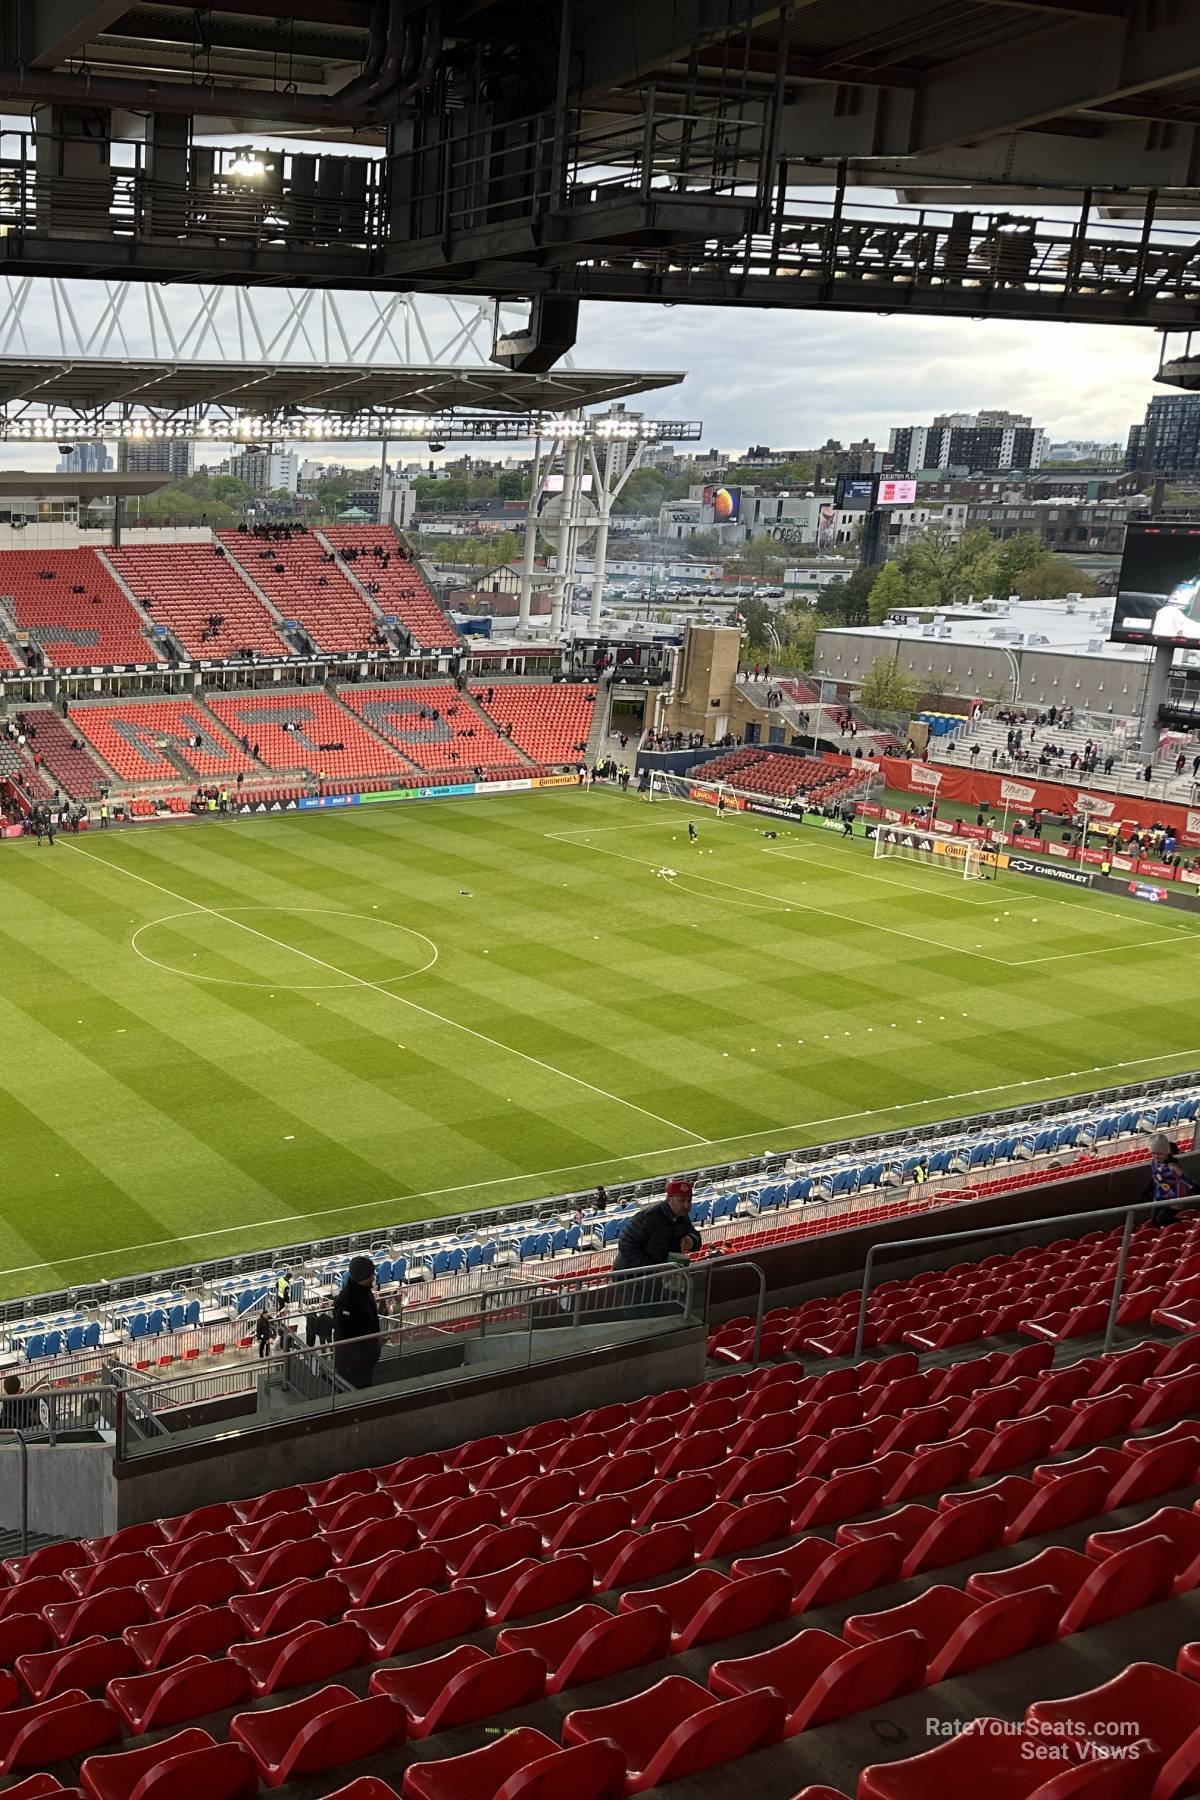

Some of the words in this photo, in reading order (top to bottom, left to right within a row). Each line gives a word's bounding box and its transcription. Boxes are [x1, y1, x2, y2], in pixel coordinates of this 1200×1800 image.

[540, 776, 571, 787] Continental
[694, 790, 713, 800] Unico
[945, 844, 989, 862] Continntal
[1035, 865, 1089, 883] CHEVROLET
